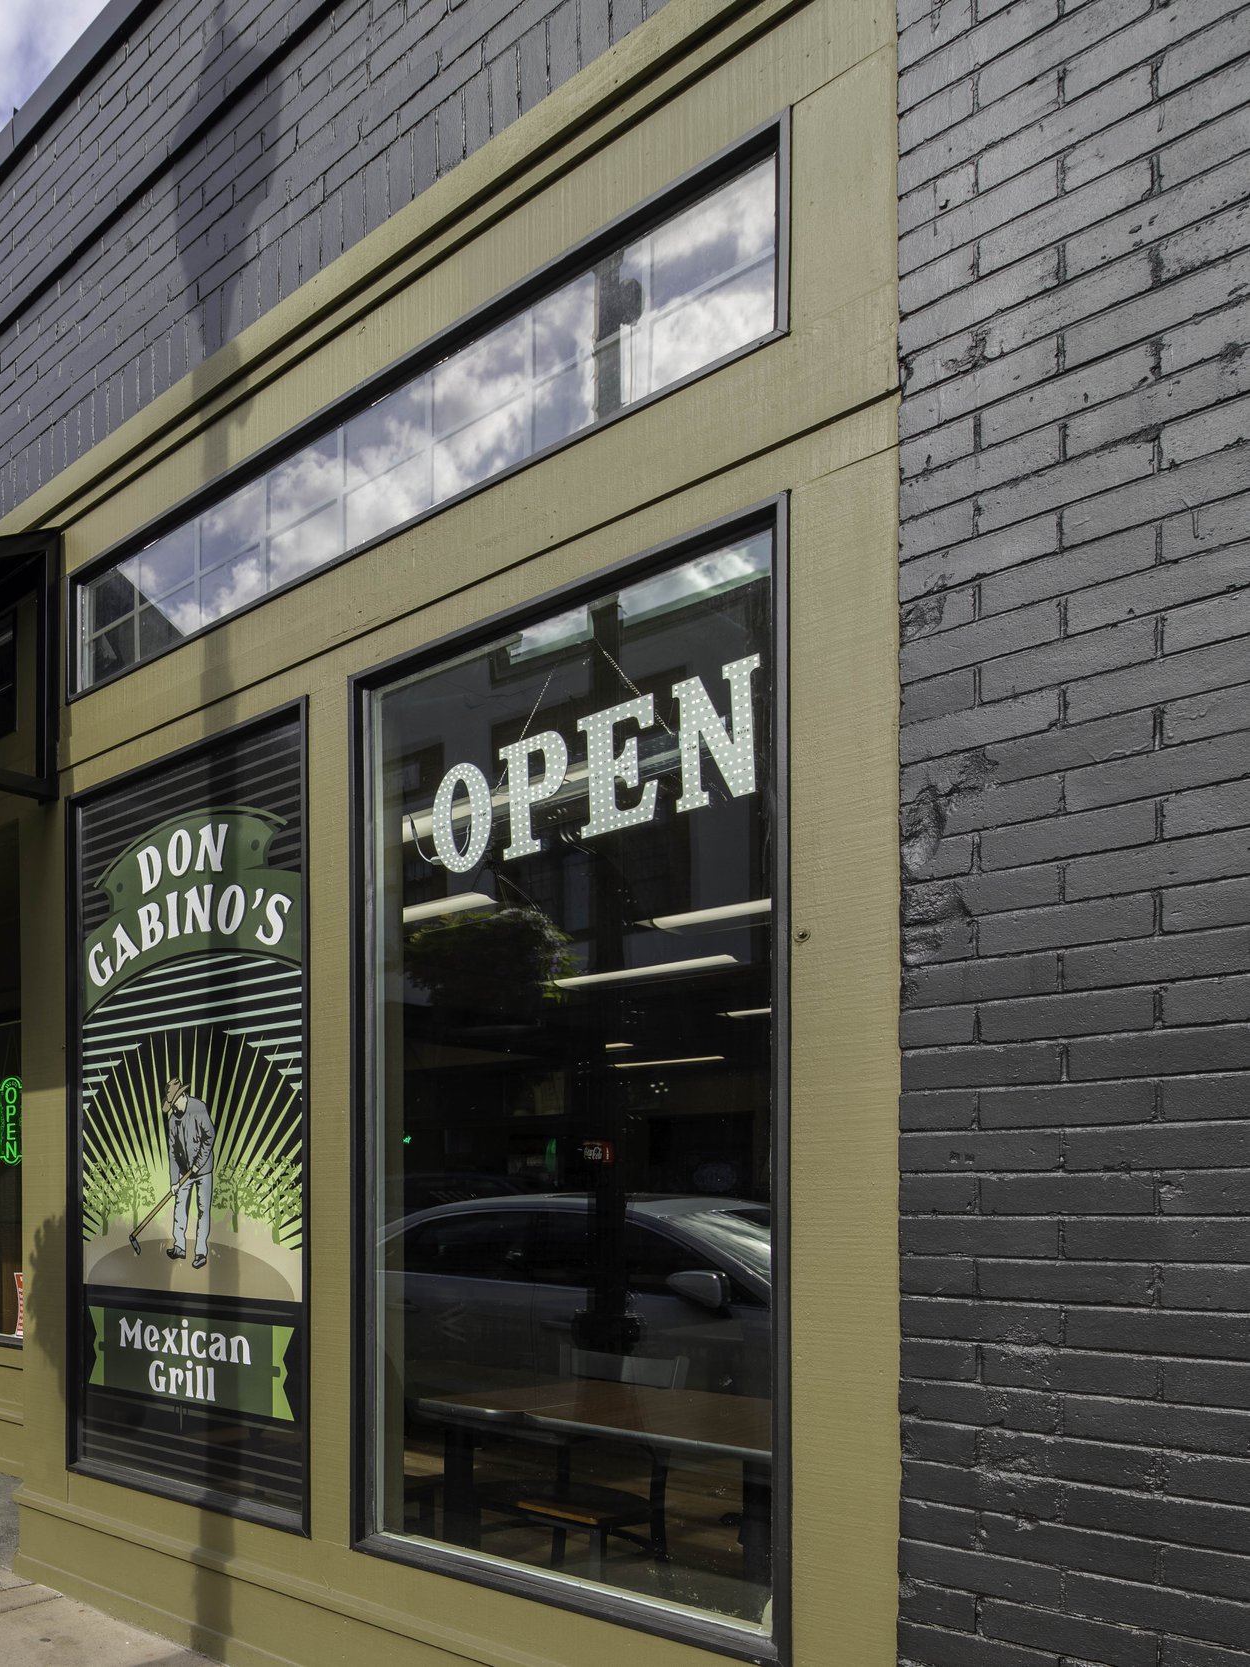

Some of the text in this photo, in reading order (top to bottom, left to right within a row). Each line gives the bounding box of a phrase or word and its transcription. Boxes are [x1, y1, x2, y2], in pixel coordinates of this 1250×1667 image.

[433, 653, 760, 873] OPEN
[137, 824, 228, 894] DON
[88, 883, 292, 987] GABINO'S
[5, 1087, 17, 1159] OPEN
[119, 1316, 252, 1365] Mexican
[148, 1360, 216, 1402] Grill
